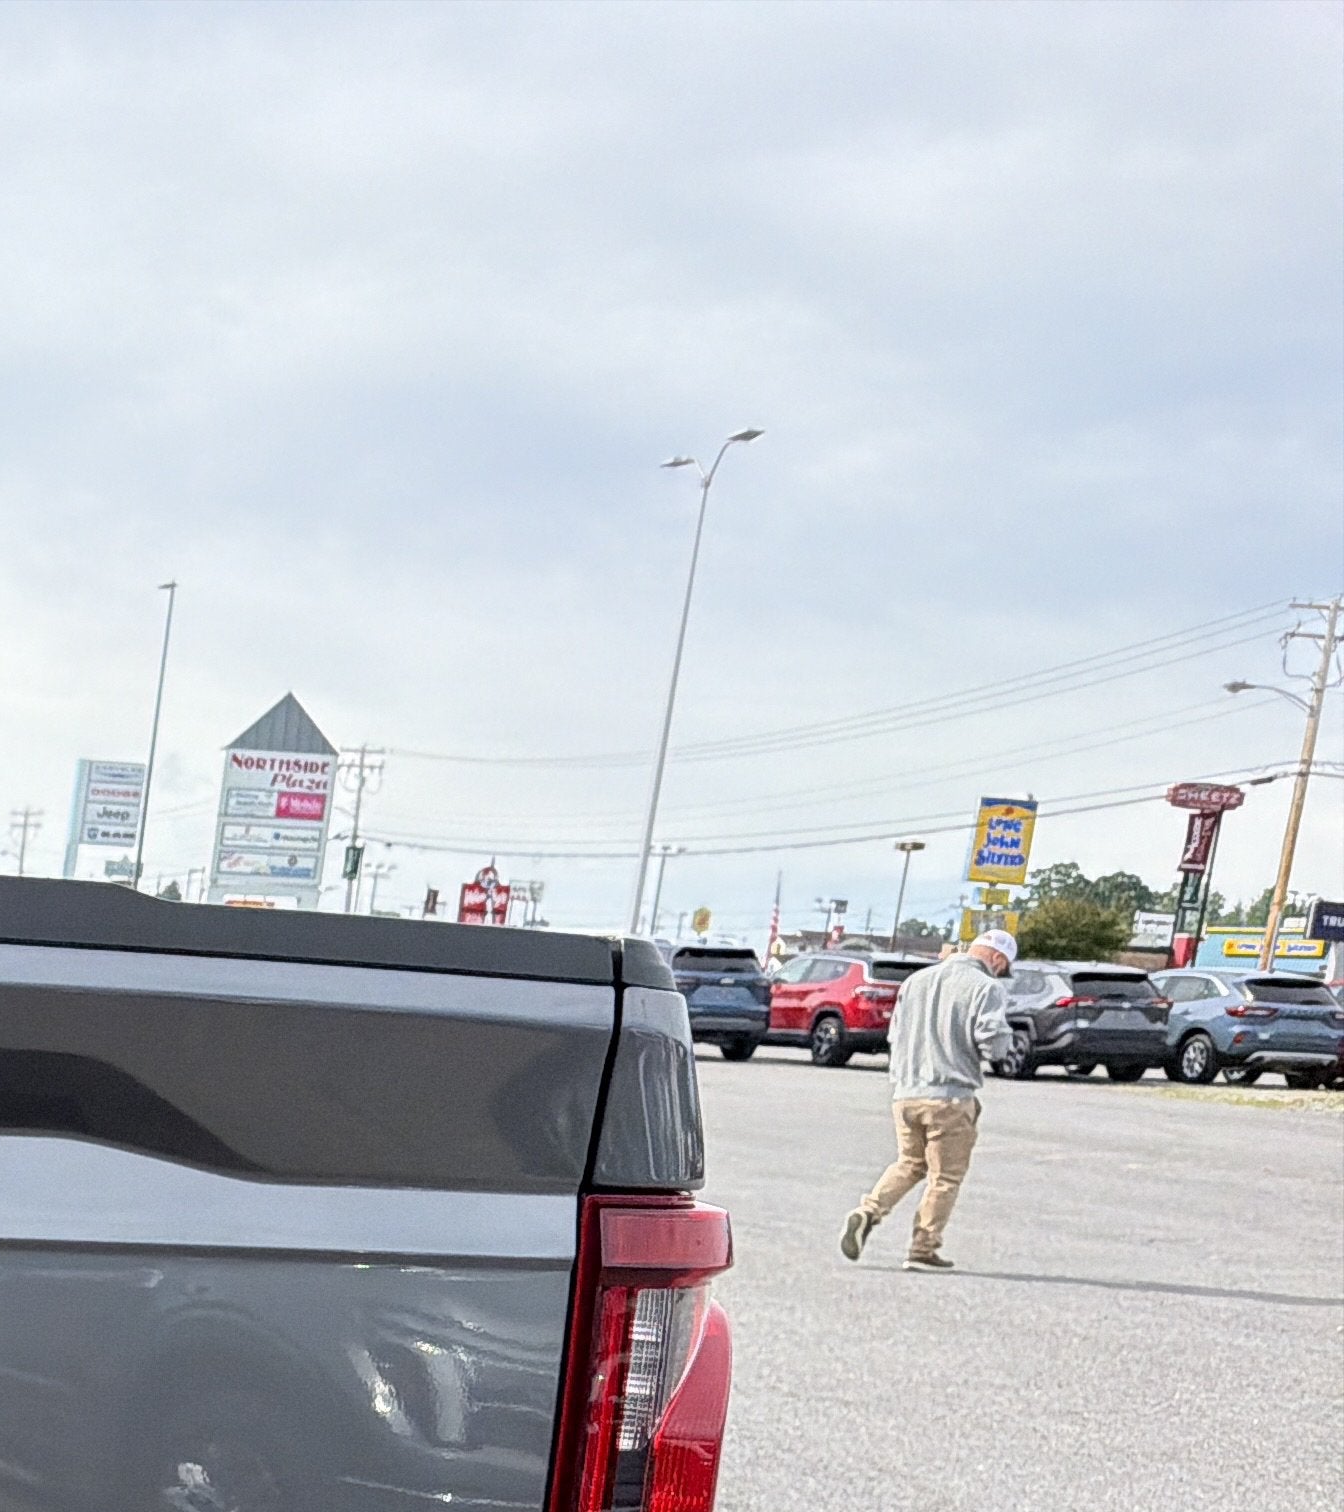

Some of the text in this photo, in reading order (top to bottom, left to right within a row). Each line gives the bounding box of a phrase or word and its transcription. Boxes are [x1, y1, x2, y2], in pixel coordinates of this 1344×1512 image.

[230, 753, 330, 775] NORTHSIDE
[270, 772, 329, 791] Plaza
[96, 806, 130, 821] Jeep
